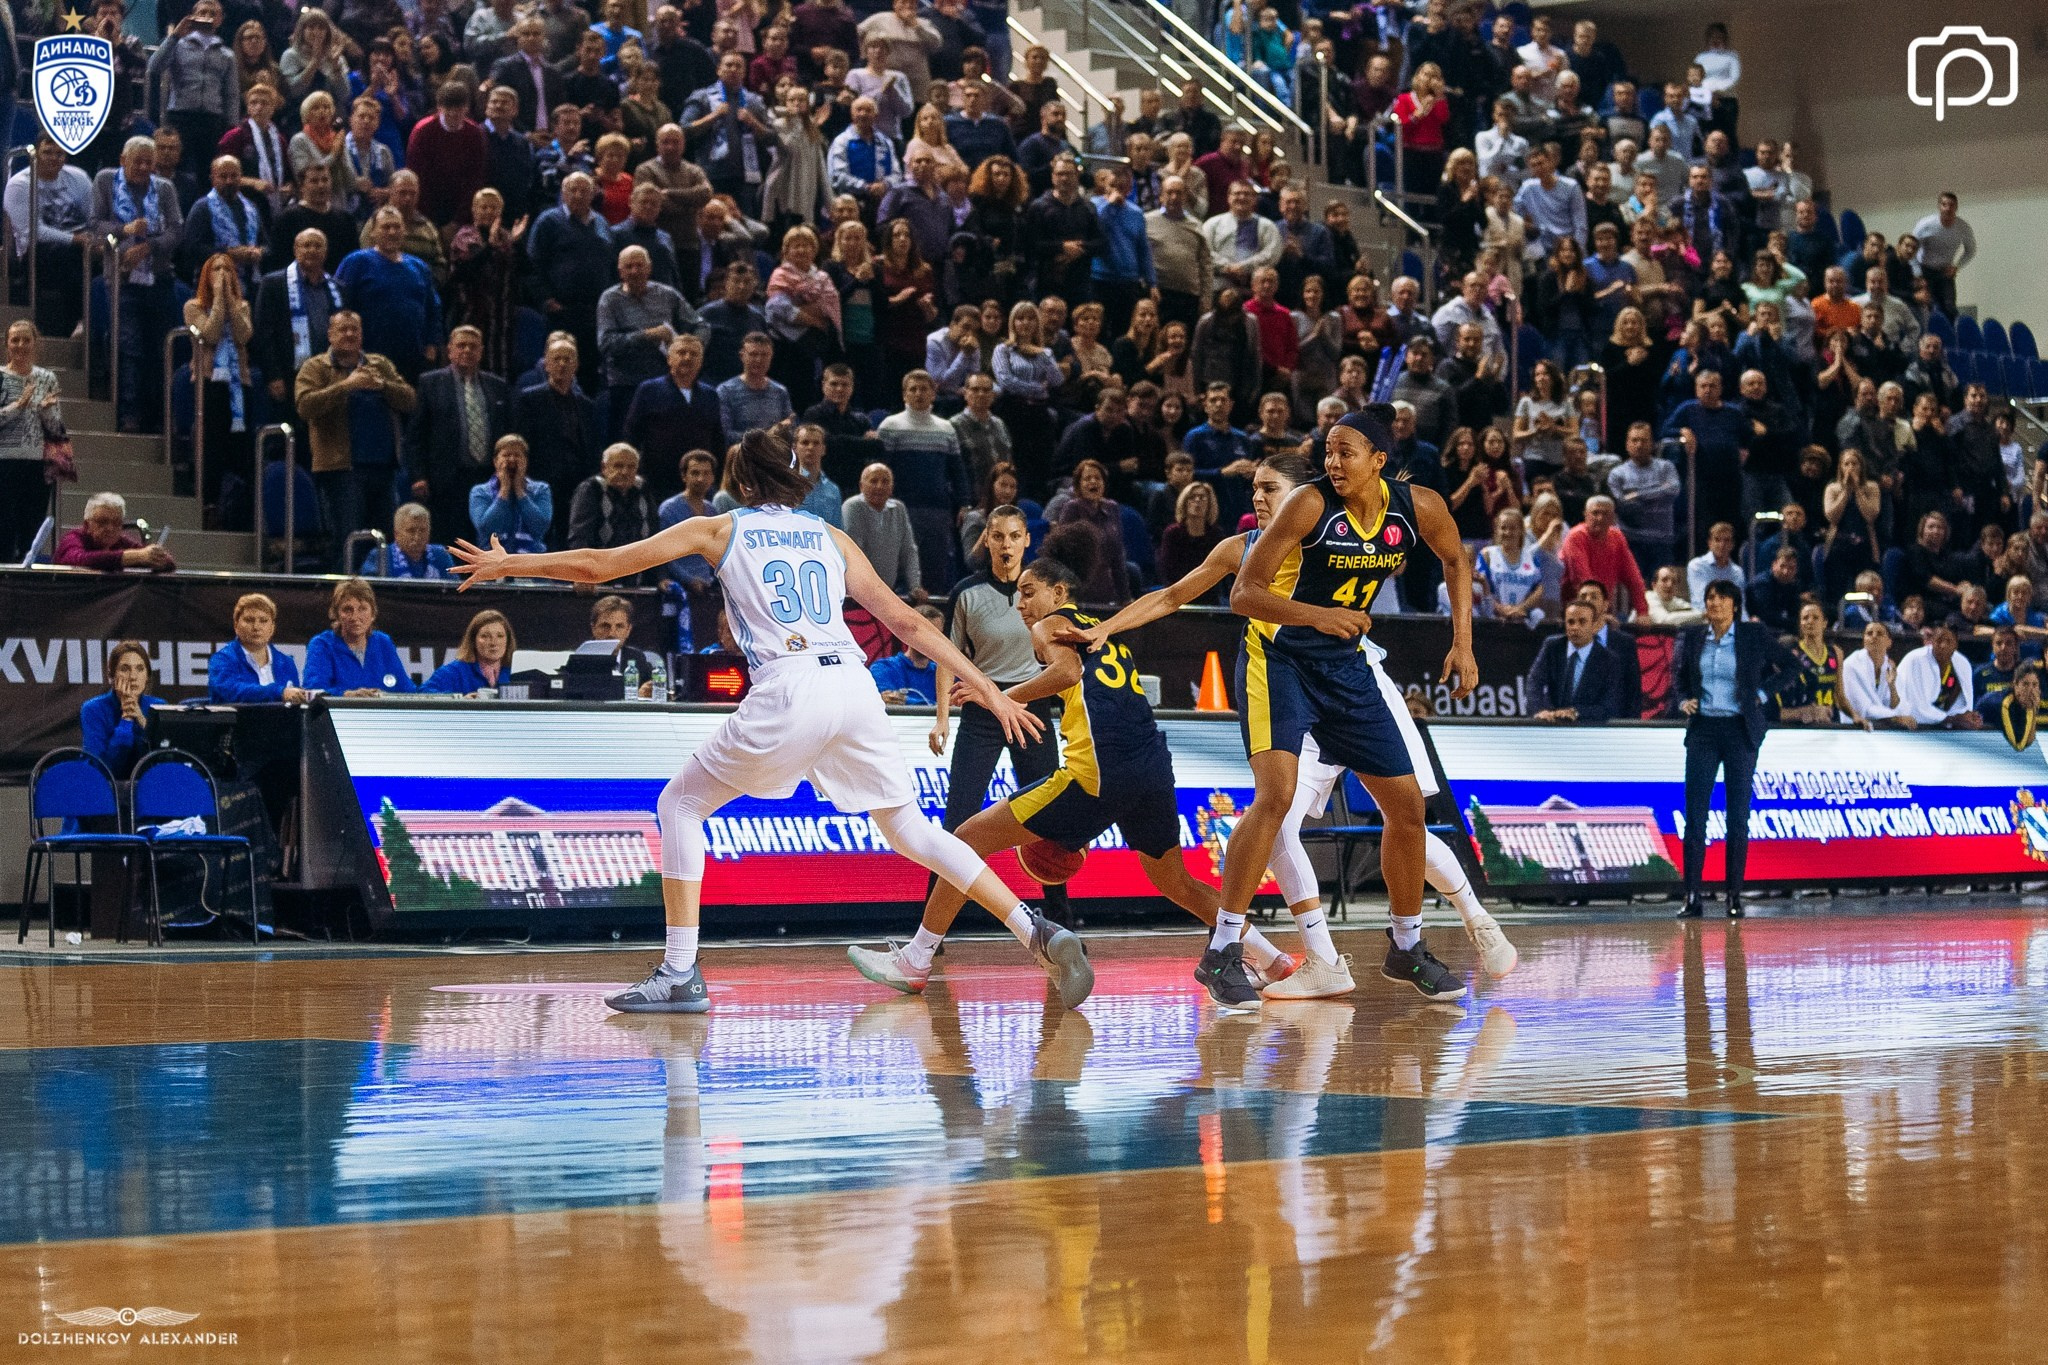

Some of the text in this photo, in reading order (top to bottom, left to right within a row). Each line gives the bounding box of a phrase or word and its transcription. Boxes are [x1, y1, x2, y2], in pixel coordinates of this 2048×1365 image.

[743, 529, 823, 551] STEWART
[763, 560, 831, 625] 30
[1332, 576, 1378, 609] 41
[1845, 803, 1932, 838] КУРСКОЙ
[1928, 806, 2012, 836] ОБЛАСТИ
